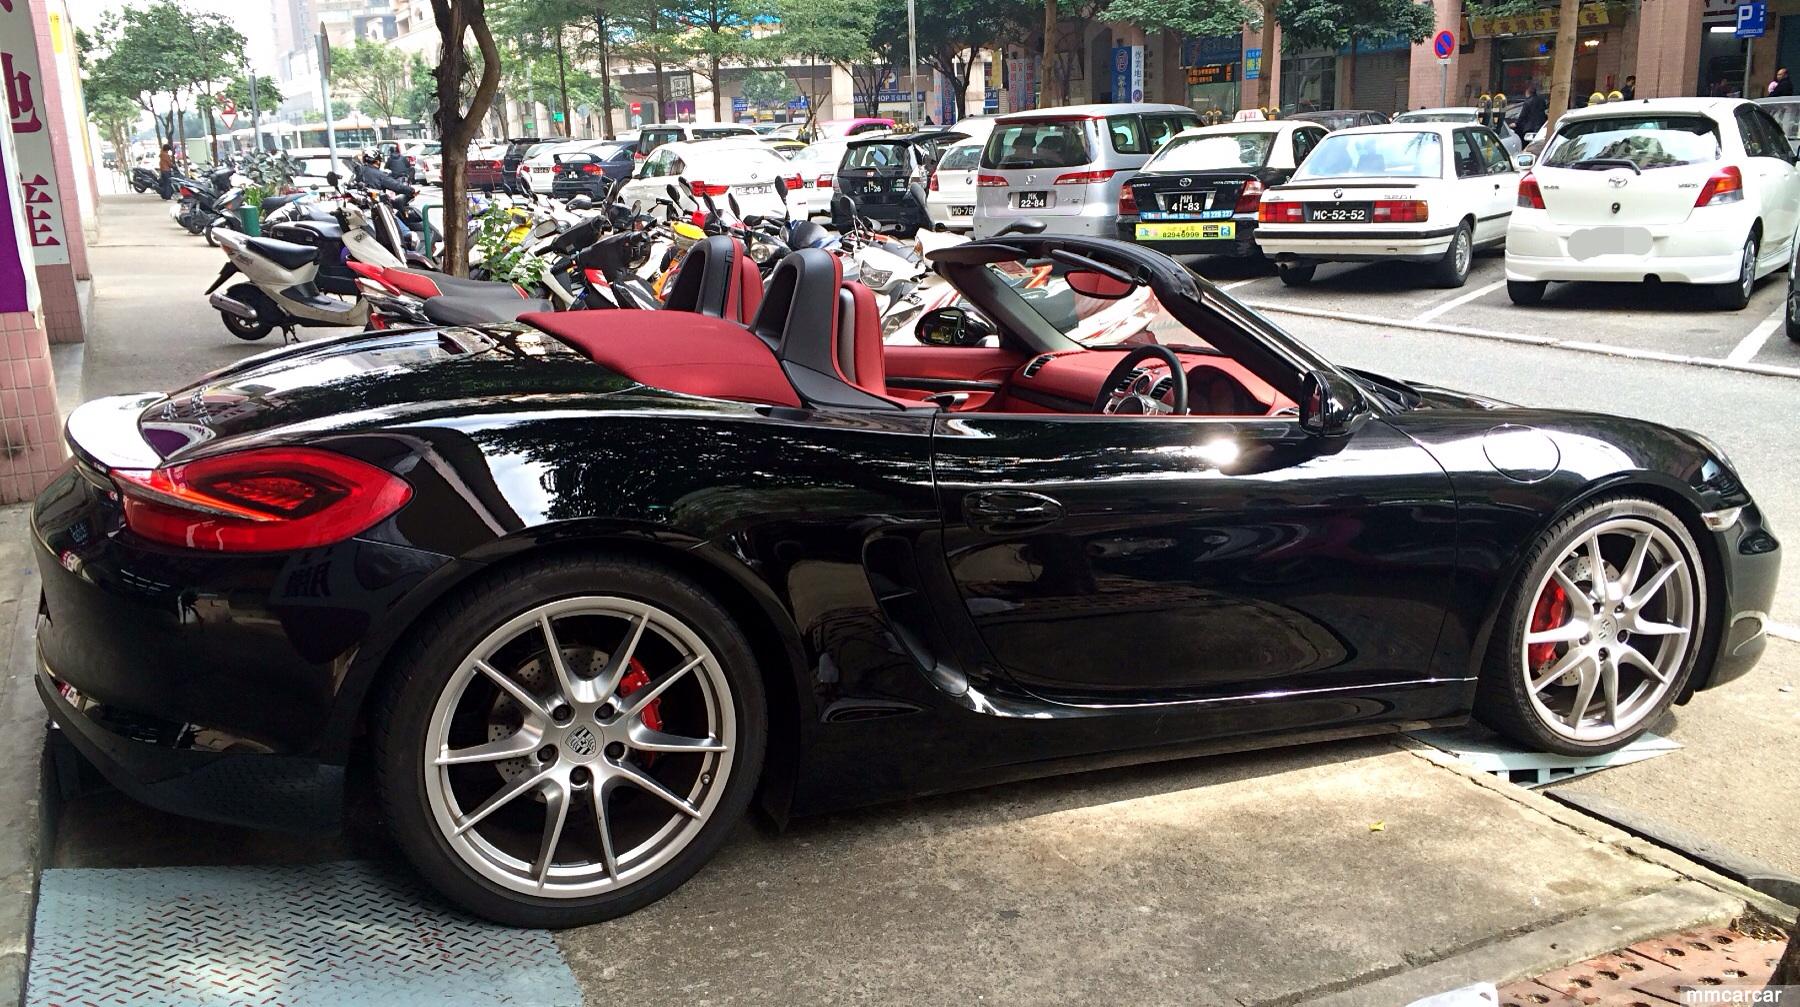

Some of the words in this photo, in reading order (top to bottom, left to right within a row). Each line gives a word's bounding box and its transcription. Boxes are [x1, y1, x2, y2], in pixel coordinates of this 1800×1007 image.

[1737, 5, 1753, 29] P
[1239, 111, 1257, 120] TAXI
[1027, 192, 1038, 200] MK
[1180, 194, 1193, 203] MM
[1020, 199, 1044, 208] 22-84
[1171, 202, 1200, 212] 41-83
[1312, 209, 1365, 221] MC-52-52
